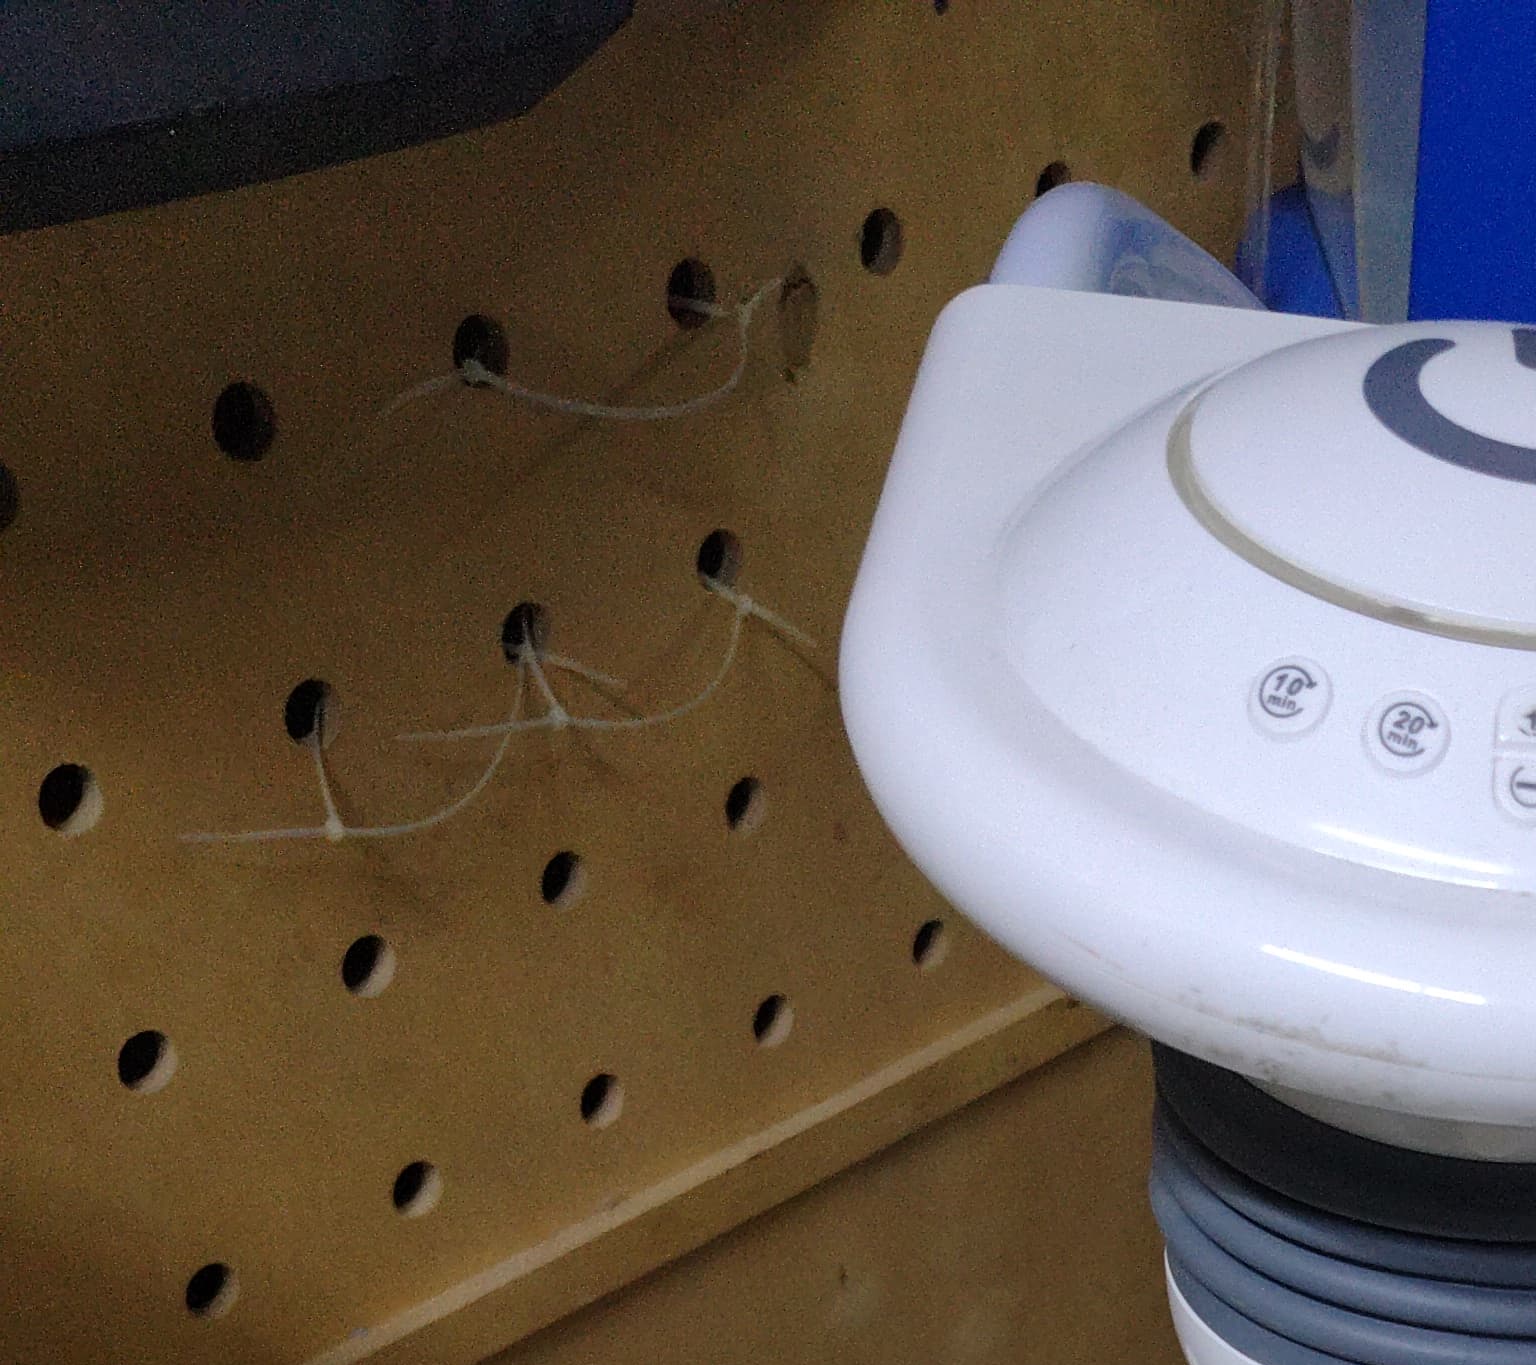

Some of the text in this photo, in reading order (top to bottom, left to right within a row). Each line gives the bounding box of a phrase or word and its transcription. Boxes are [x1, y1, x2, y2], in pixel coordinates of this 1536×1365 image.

[1274, 673, 1304, 696] 10
[1266, 694, 1296, 711] min
[1392, 710, 1425, 734] 20
[1387, 731, 1418, 750] min
